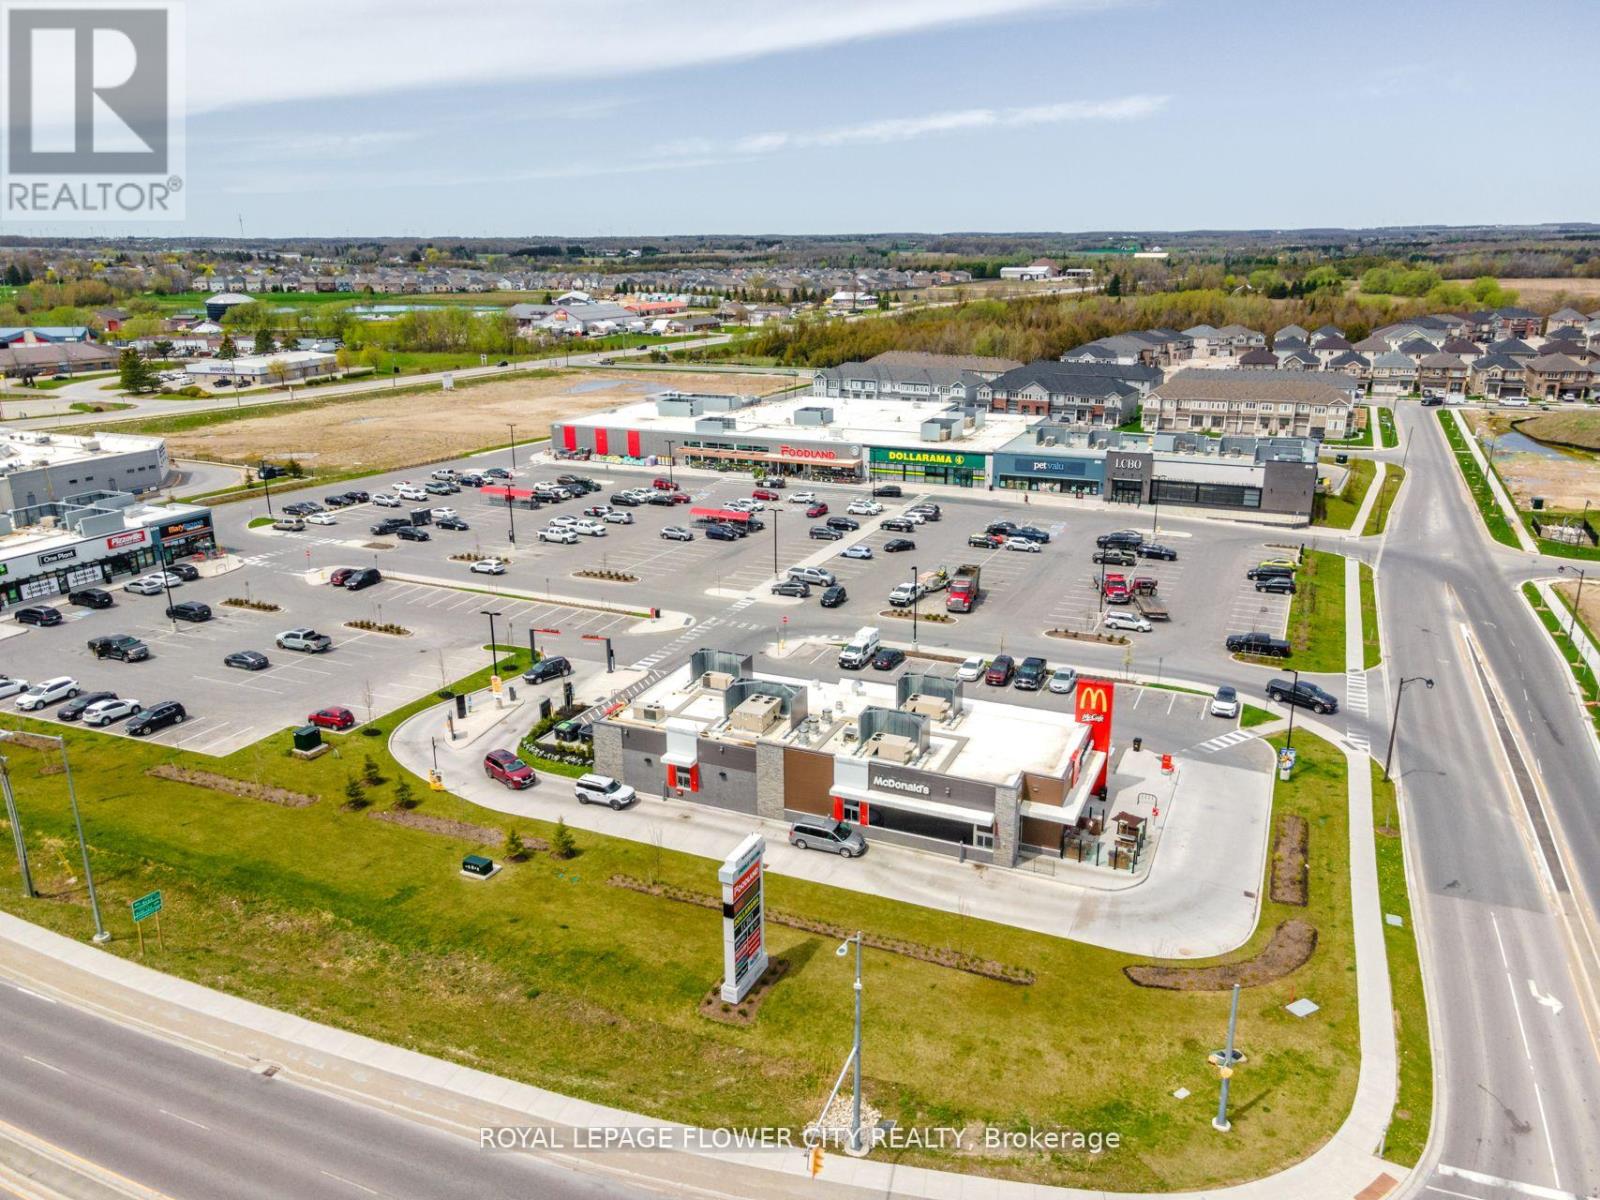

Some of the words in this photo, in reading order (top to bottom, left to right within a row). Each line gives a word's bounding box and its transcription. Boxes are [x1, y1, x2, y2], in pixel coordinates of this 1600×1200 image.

[780, 446, 836, 460] FOODLAND
[888, 451, 952, 464] DOLLARAMA
[1115, 458, 1142, 470] LCBO
[57, 551, 74, 561] Plant
[873, 776, 930, 794] McDonald's
